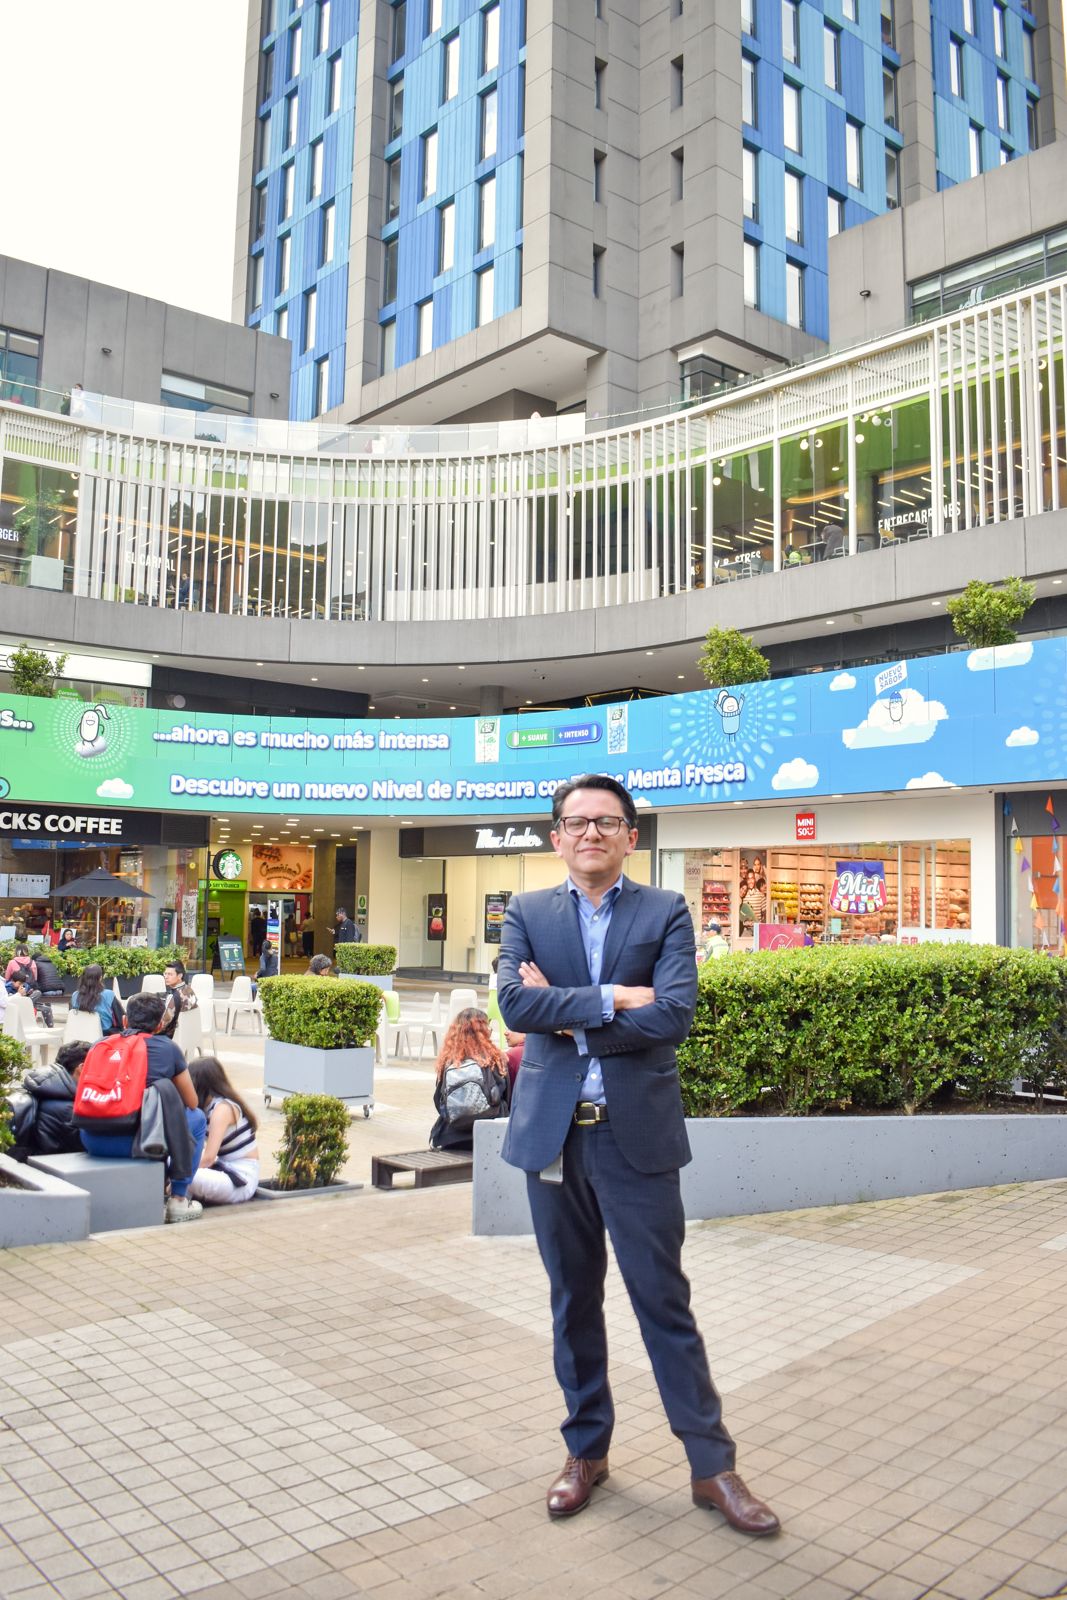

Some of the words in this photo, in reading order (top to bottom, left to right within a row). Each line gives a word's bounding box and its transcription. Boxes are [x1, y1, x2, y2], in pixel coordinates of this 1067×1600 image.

[878, 501, 961, 531] ENTRECARNES
[723, 551, 761, 566] PSTRES
[879, 665, 902, 683] NUEVO
[880, 673, 903, 690] SABOR
[234, 728, 257, 746] es
[261, 729, 330, 749] mucho
[333, 729, 374, 750] más
[379, 730, 450, 750] intensa
[527, 733, 548, 742] SUAVE
[563, 729, 589, 739] INTENSO
[170, 775, 270, 797] Descubre
[273, 781, 301, 798] un
[305, 781, 368, 800] nuevo
[373, 779, 424, 800] Nivel
[428, 780, 452, 800] de
[456, 778, 535, 799] Frescura
[627, 768, 682, 790] Menta
[685, 761, 747, 785] Fresca
[0, 812, 41, 831] CKS
[44, 814, 123, 835] COFFEE
[797, 818, 814, 827] MINI
[838, 870, 881, 896] Mid
[832, 898, 884, 912] SEASON
